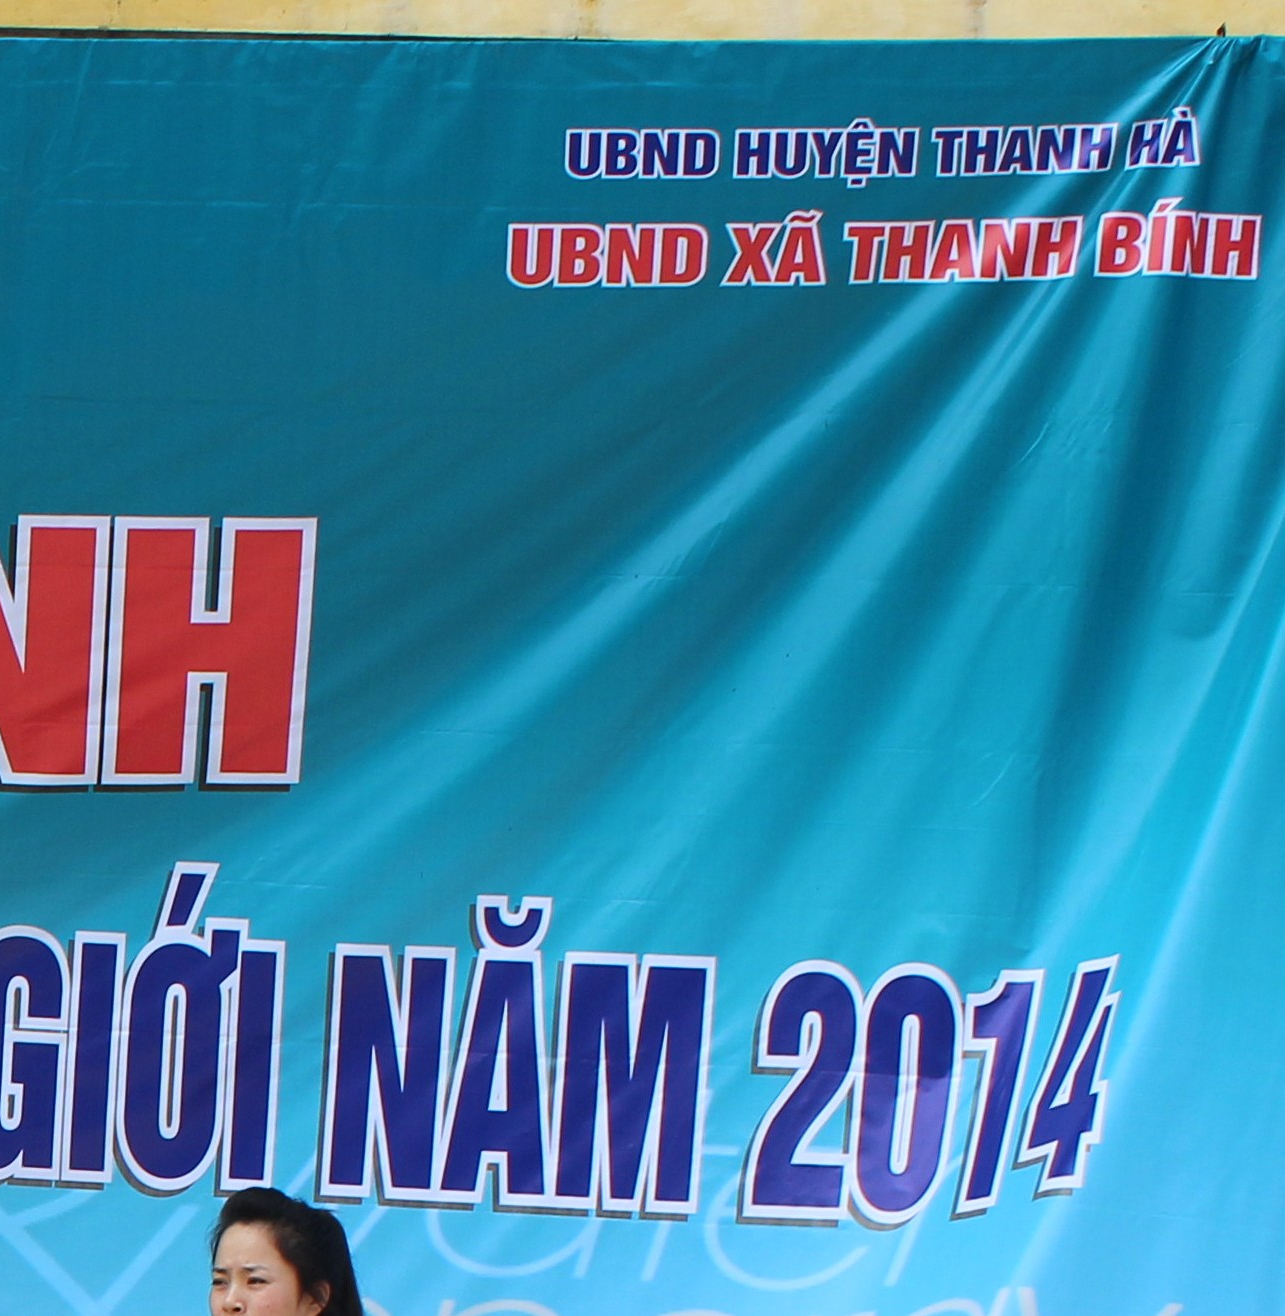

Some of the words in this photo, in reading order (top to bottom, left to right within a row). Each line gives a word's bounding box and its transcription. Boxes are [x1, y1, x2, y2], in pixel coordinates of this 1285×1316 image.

[565, 128, 720, 180] UBND
[732, 118, 918, 187] HUYỆN
[931, 122, 1118, 176] THANH
[1128, 107, 1200, 170] HÀ
[506, 222, 708, 288] UBND
[720, 210, 827, 286] XÃ
[844, 215, 1083, 284] THANH
[1093, 197, 1262, 280] BÍNH
[316, 893, 717, 1220] NĂM
[738, 954, 1121, 1227] 2014
